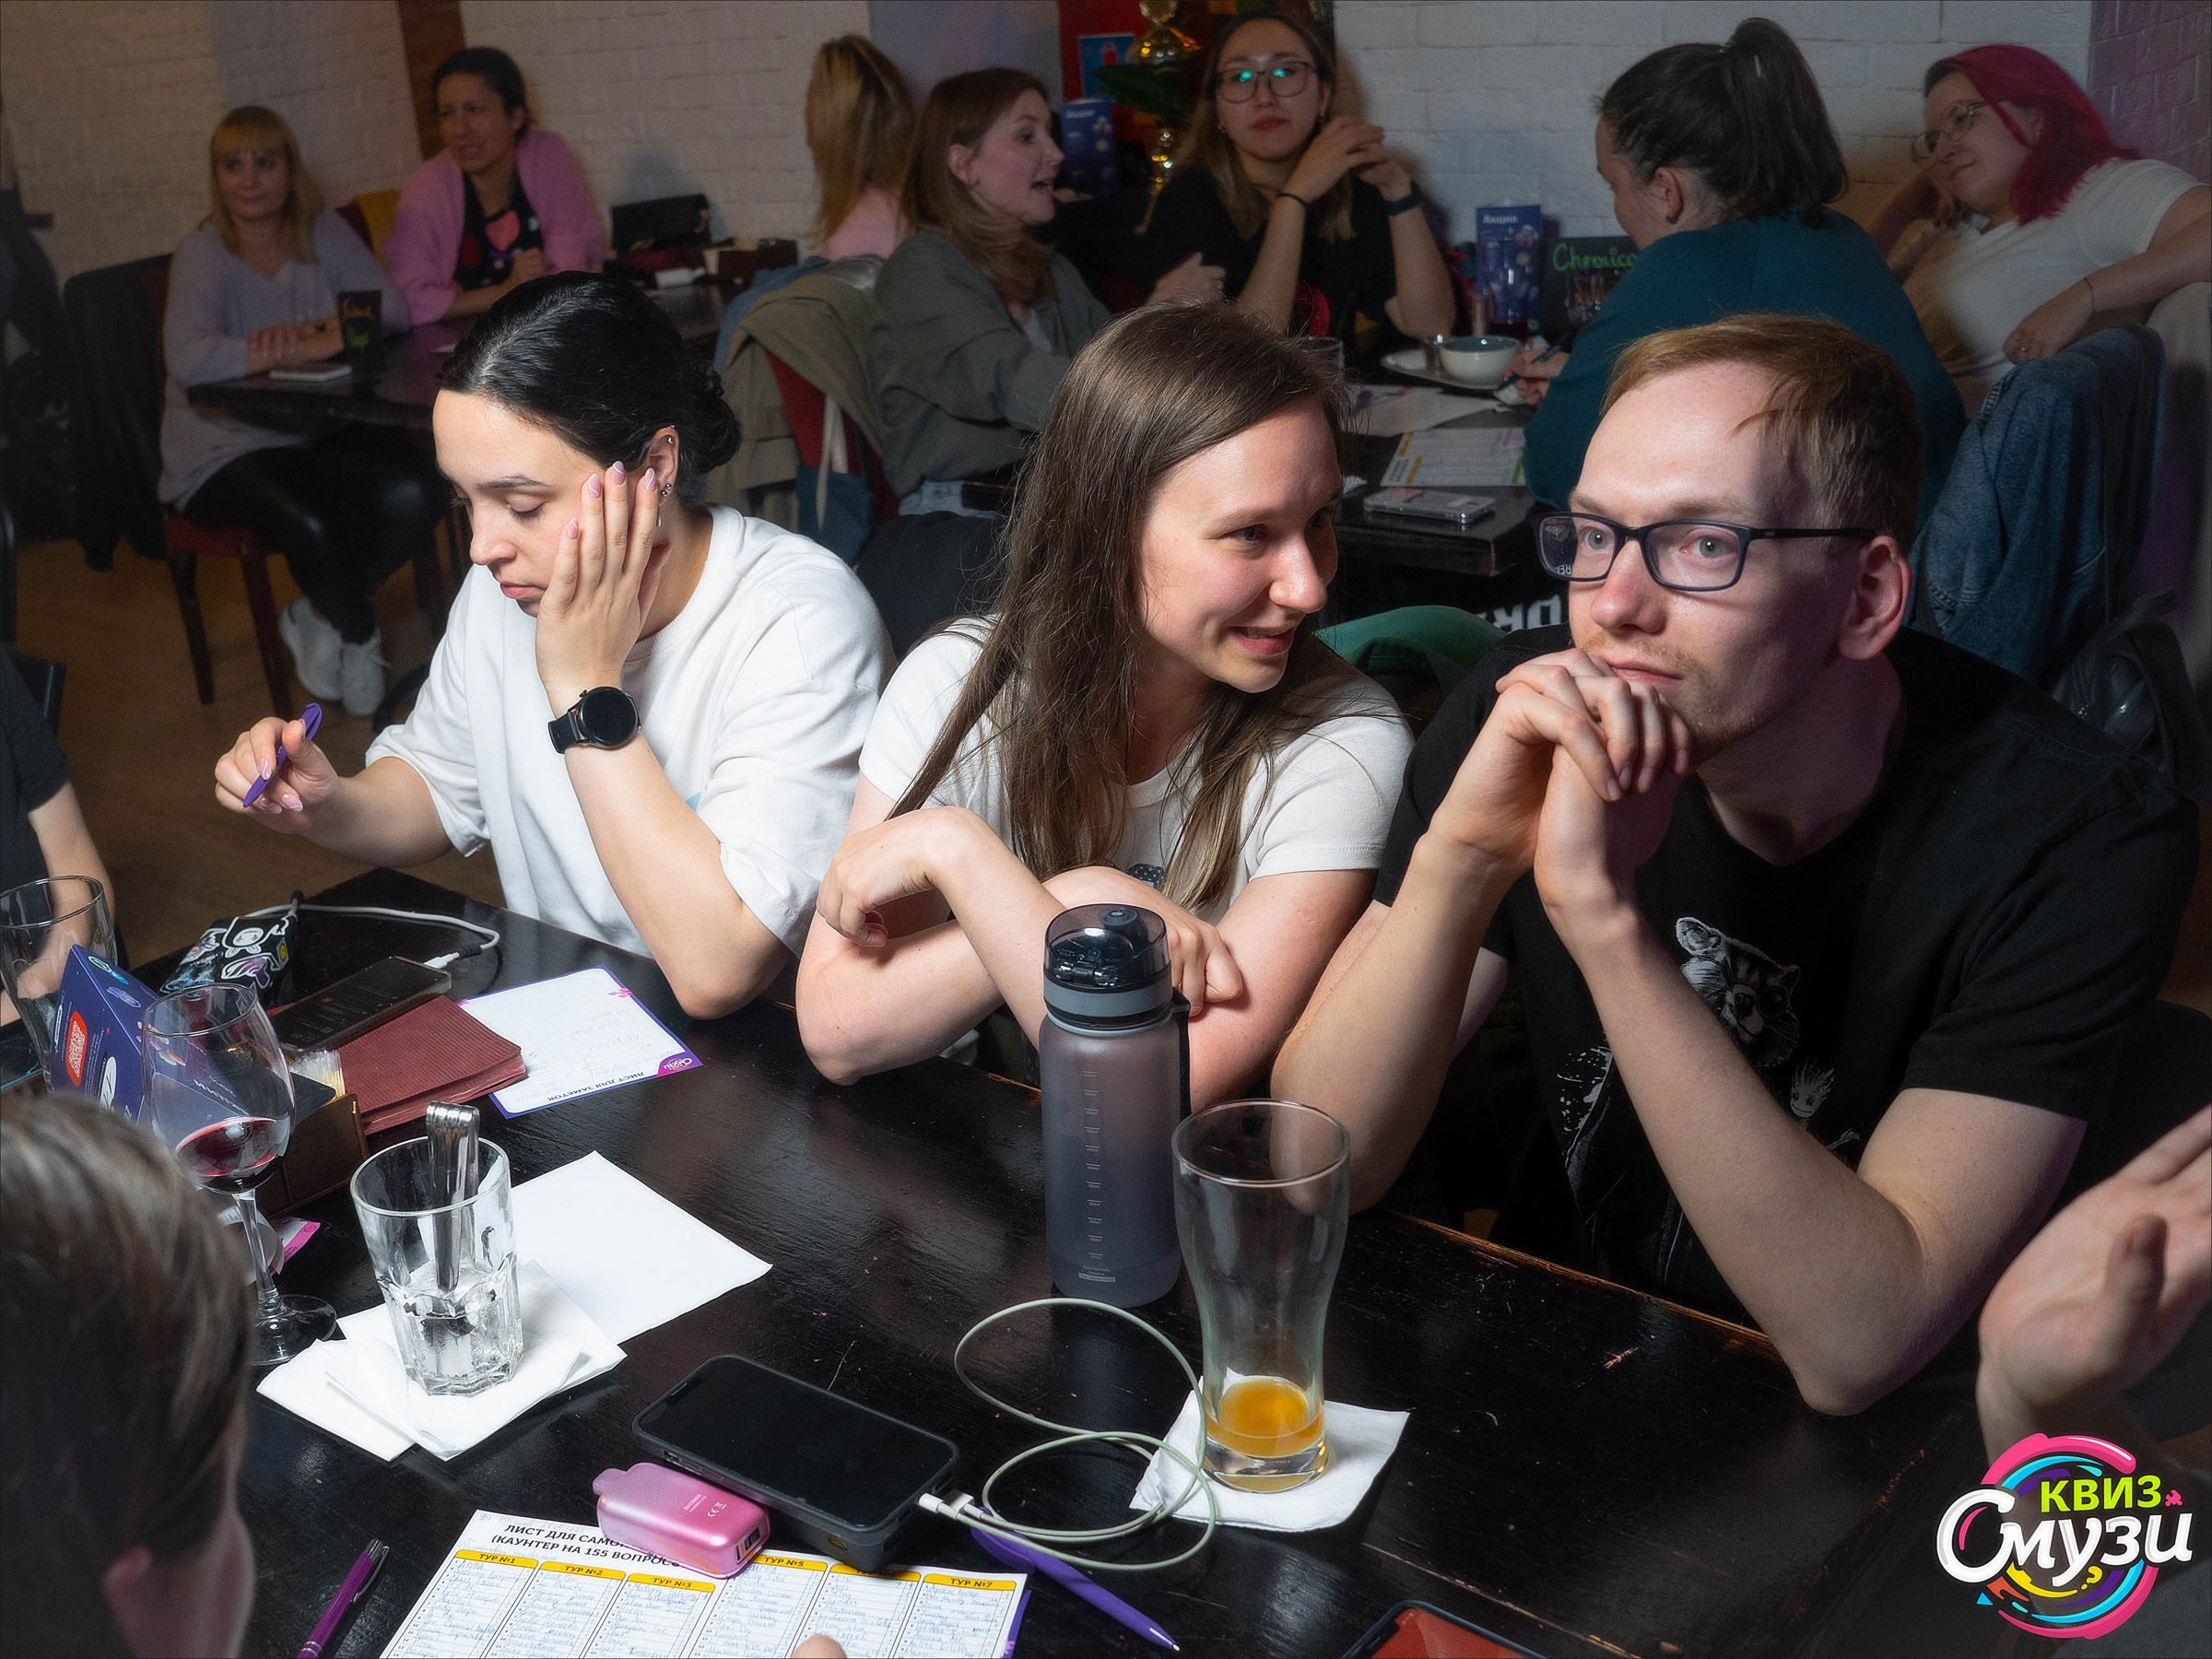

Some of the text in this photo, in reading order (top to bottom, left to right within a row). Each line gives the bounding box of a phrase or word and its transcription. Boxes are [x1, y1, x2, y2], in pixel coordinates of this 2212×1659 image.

[547, 1071, 644, 1101] ЛИСТ ДЛЯ ЗАМЕТОК
[504, 1524, 545, 1536] ЛИСТ
[545, 1530, 577, 1540] ДЛЯ
[491, 1535, 559, 1551] (КАУНТЕР
[561, 1545, 581, 1554] НА
[584, 1547, 608, 1558] 155
[478, 1553, 500, 1562] ТУР
[764, 1556, 784, 1565] ТУР
[564, 1565, 585, 1574] ТУР
[653, 1577, 692, 1588] ТУР №3
[950, 1577, 972, 1586] ТУР
